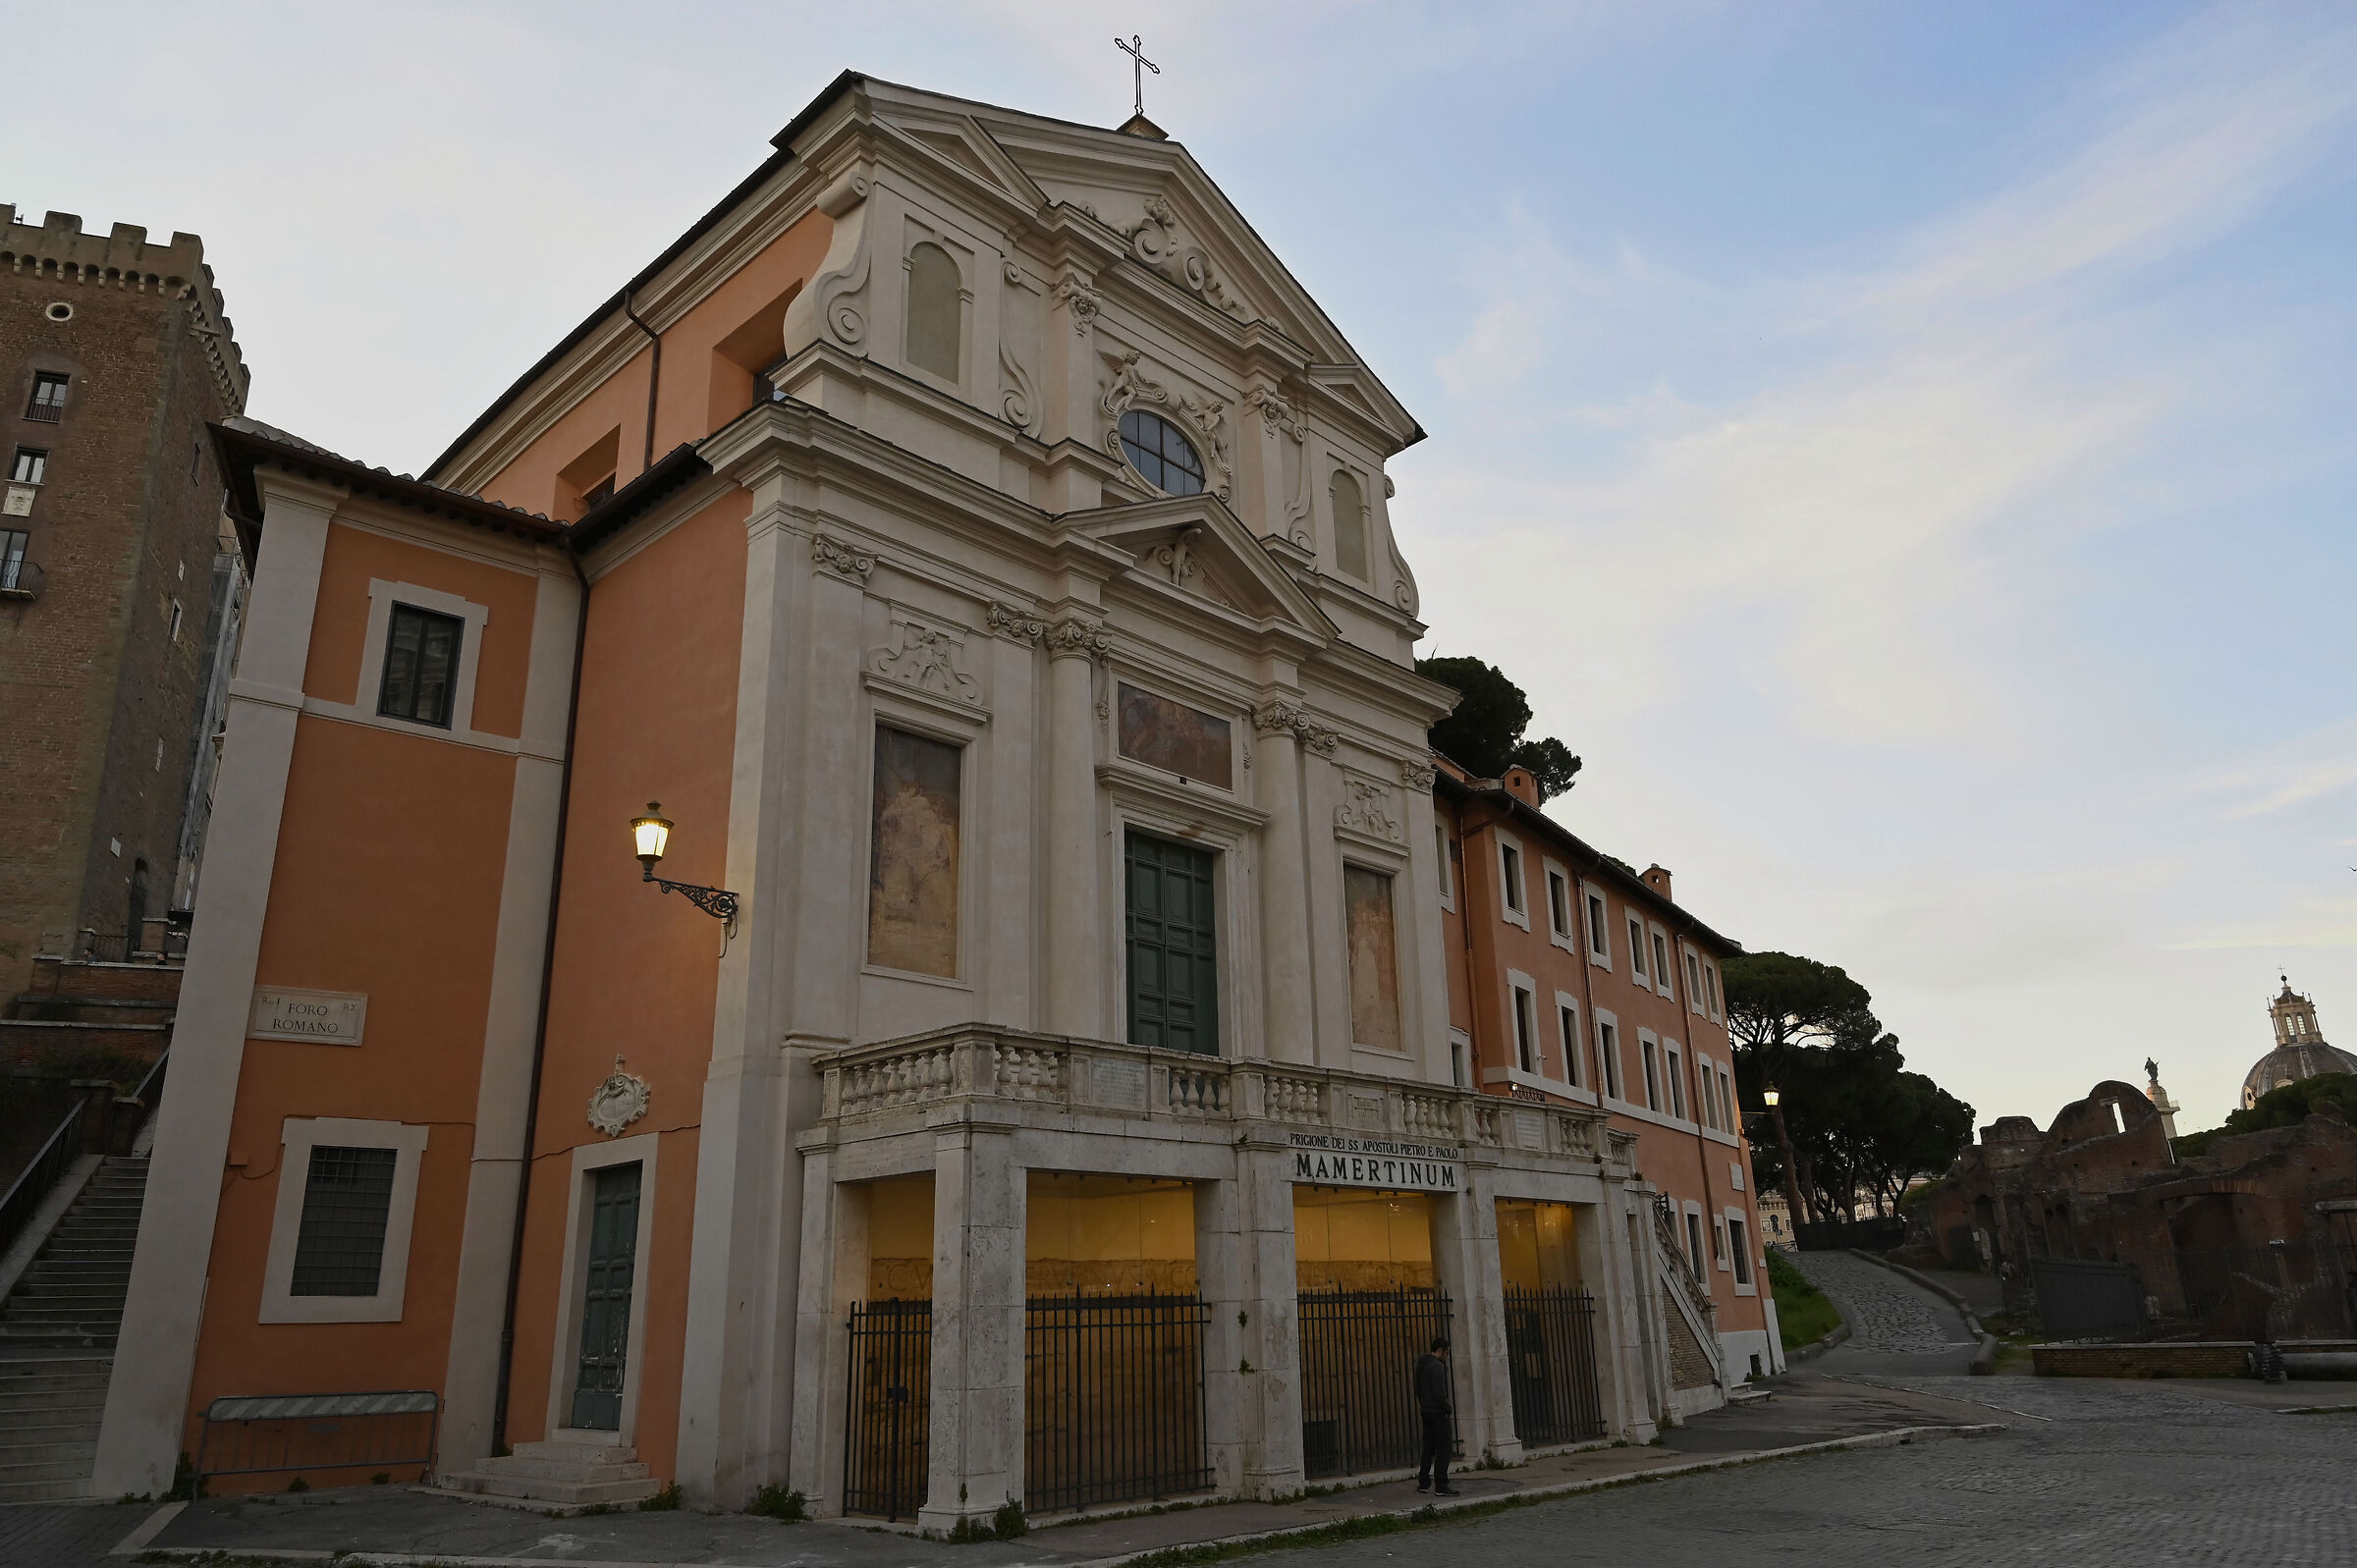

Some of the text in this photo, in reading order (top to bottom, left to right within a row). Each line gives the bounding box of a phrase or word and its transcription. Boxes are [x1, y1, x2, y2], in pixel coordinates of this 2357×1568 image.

[288, 1003, 328, 1016] FORO
[273, 1018, 339, 1033] ROMANO
[1289, 1132, 1458, 1160] PRIGIONE DEI SS APOSTOLI PIETRO E PAOLO
[1296, 1153, 1455, 1187] MAMERTINUM
